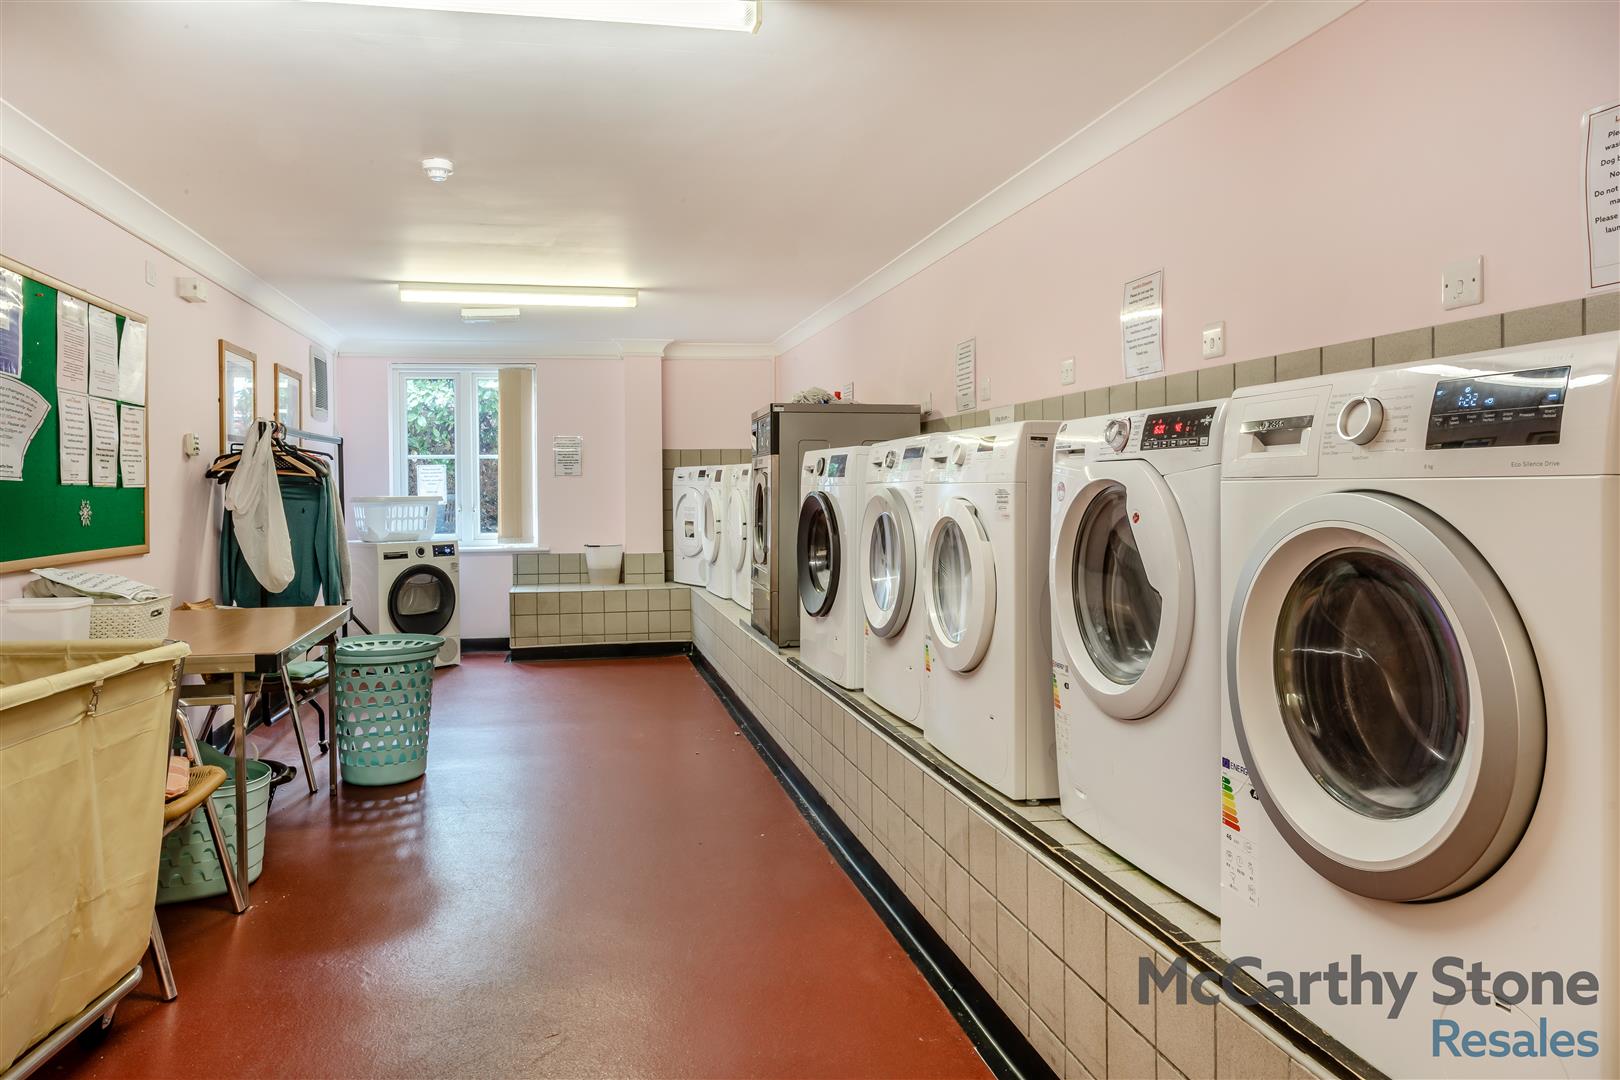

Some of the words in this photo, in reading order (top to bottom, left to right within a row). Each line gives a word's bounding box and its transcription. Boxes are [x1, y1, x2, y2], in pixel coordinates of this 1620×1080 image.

[1605, 142, 1620, 150] was
[1600, 158, 1616, 166] Dog
[1594, 190, 1605, 198] Do
[1606, 186, 1618, 194] not
[1594, 214, 1619, 224] Please
